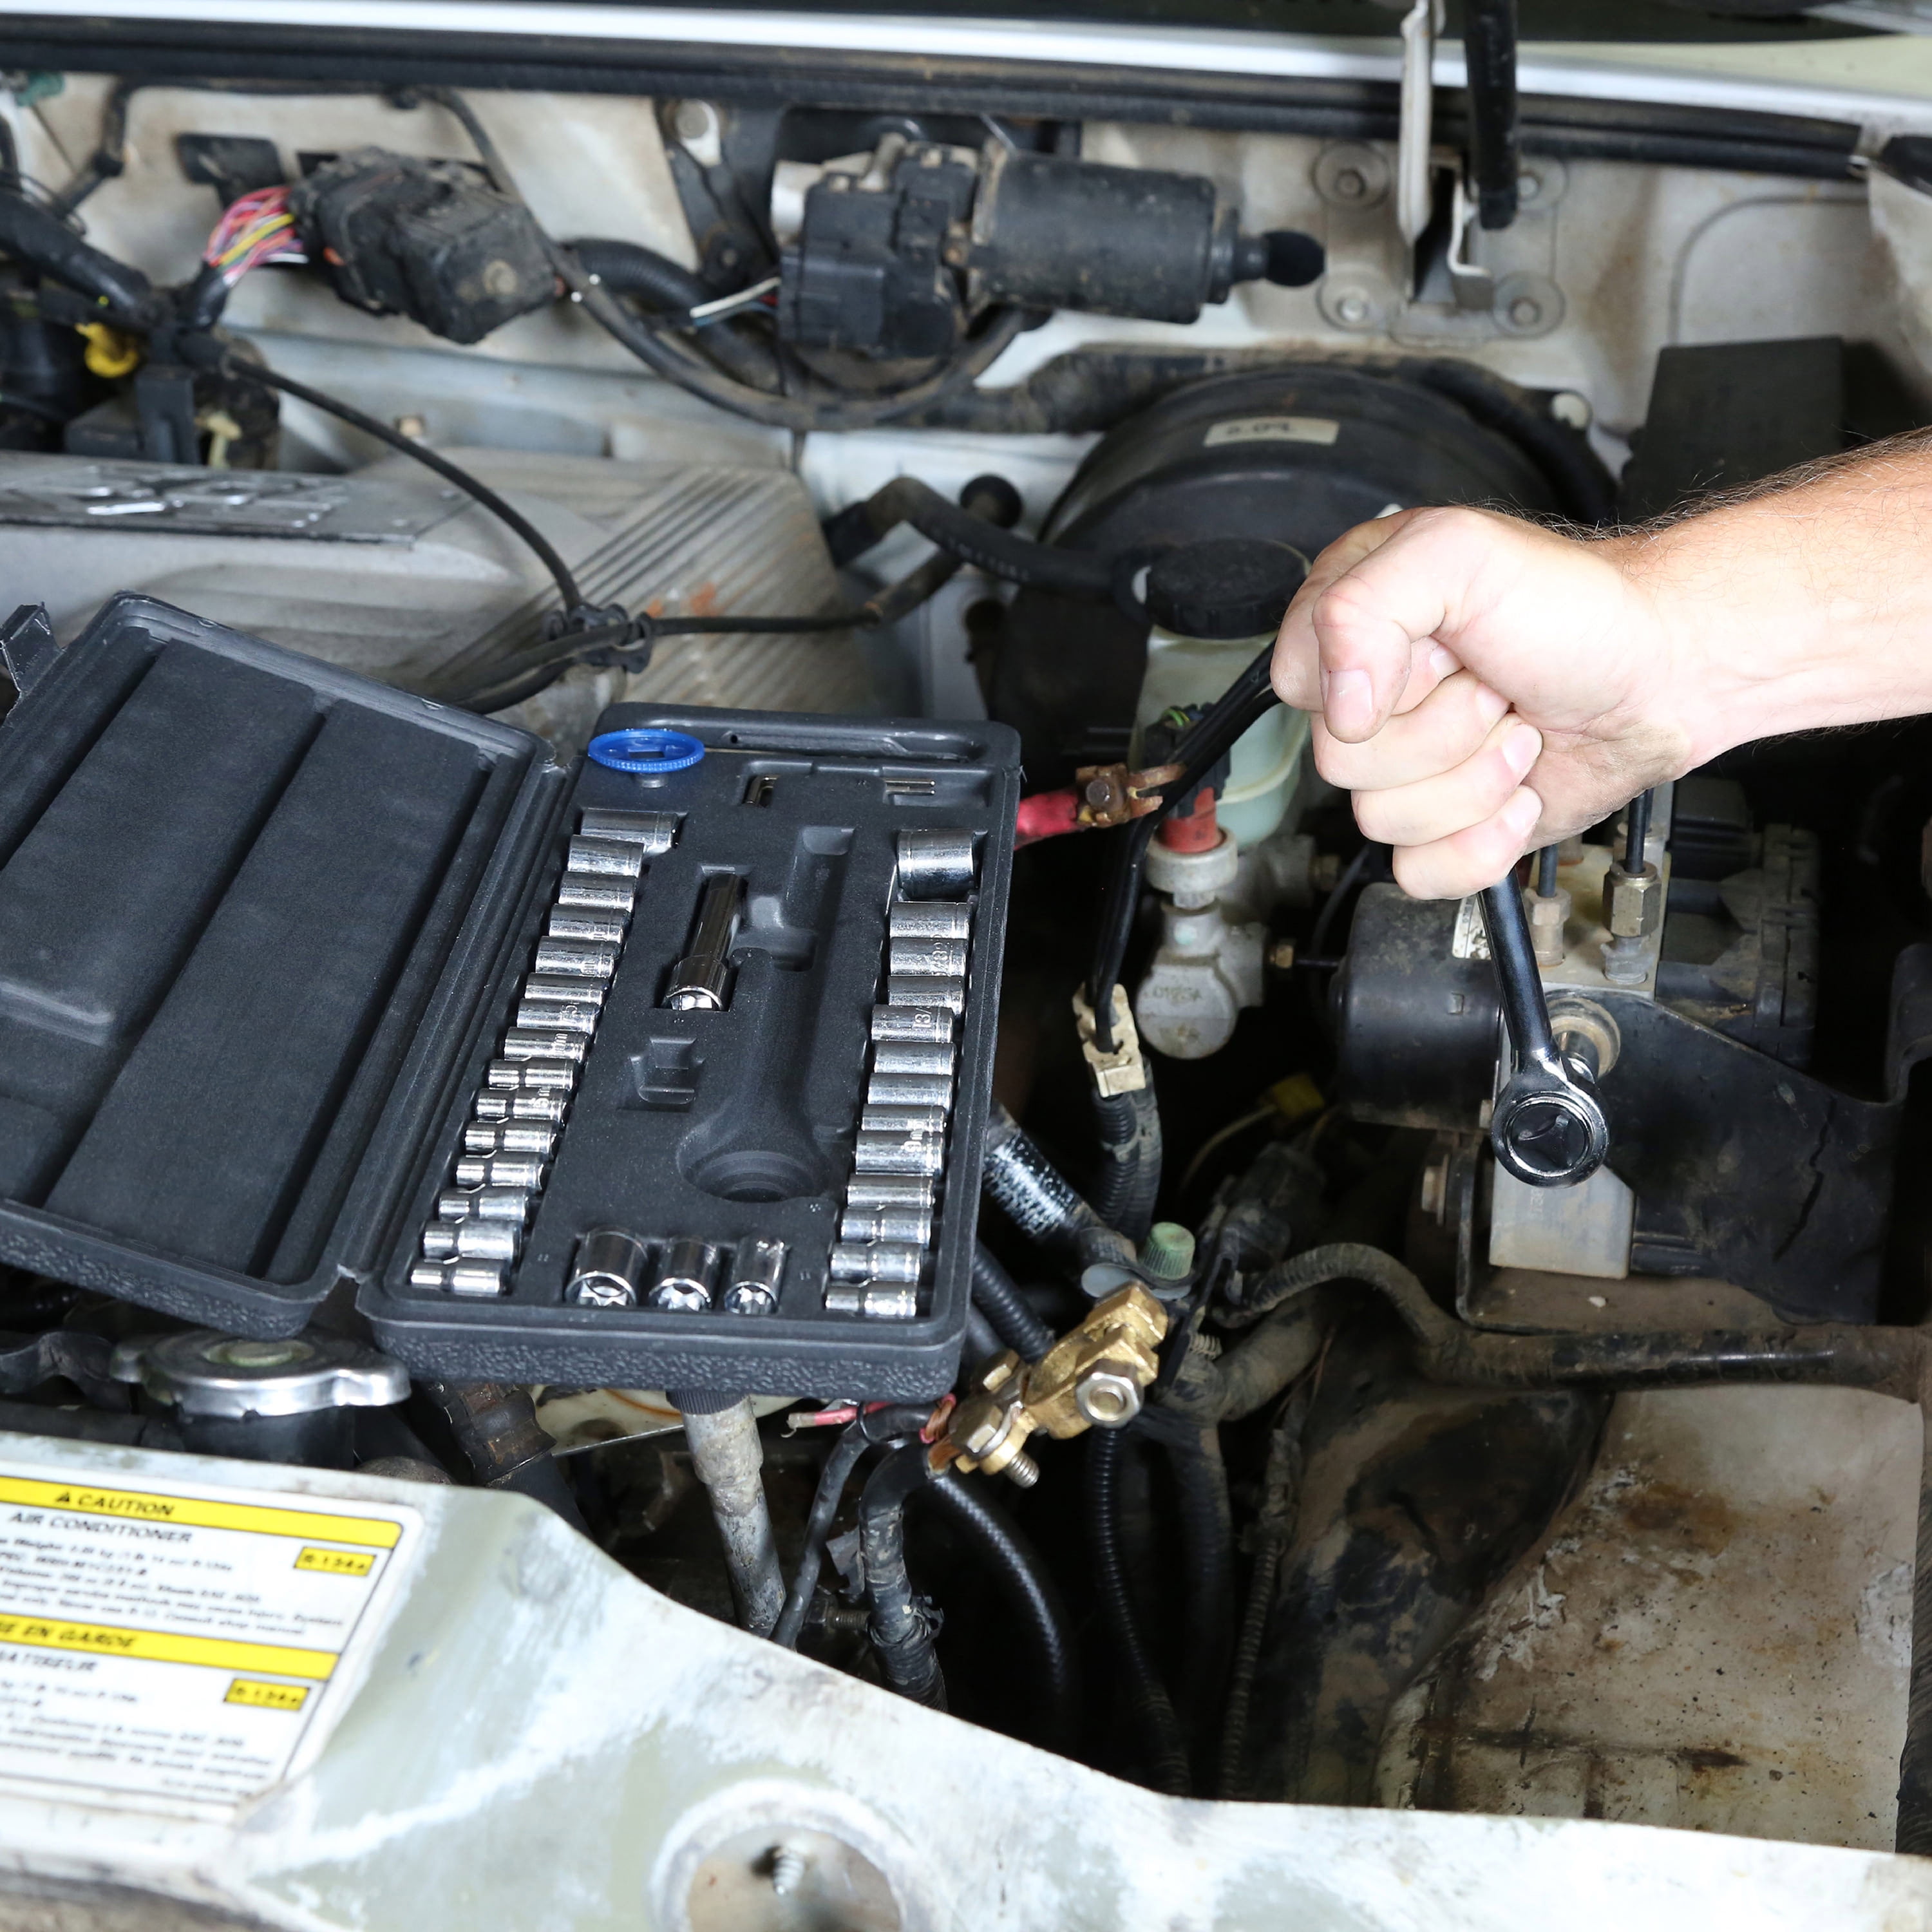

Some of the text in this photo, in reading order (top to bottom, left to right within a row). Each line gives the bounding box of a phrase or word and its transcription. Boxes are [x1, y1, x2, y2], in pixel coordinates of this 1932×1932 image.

[912, 1006, 932, 1028] 13/
[78, 1493, 175, 1516] CAUTION
[10, 1511, 193, 1542] AIR CONDITIONER
